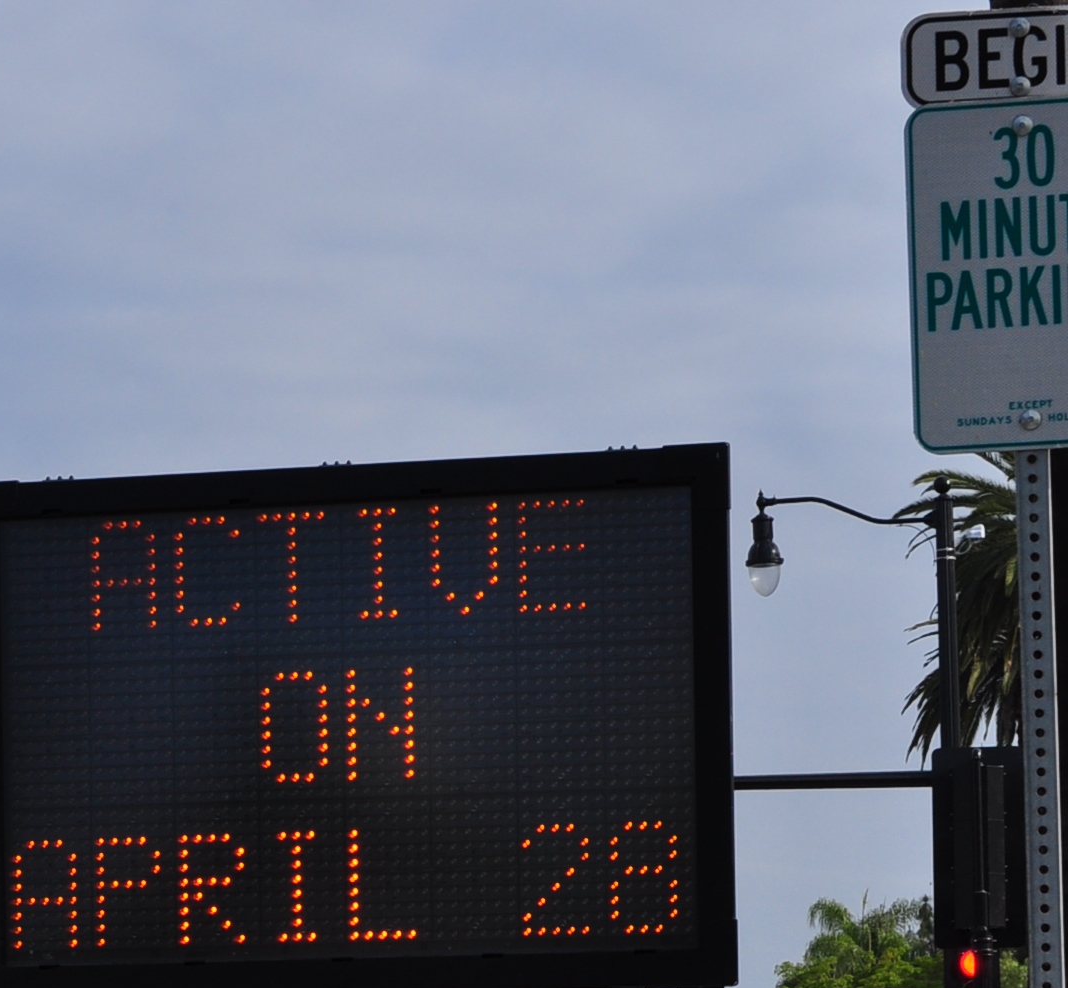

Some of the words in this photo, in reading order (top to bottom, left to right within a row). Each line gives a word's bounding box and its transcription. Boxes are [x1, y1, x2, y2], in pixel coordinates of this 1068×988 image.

[935, 24, 1067, 91] BEGI
[993, 124, 1055, 190] 30
[957, 415, 1013, 427] SUNDAYS
[1008, 399, 1053, 410] EXCEPT
[90, 499, 588, 632] ACTIVE
[260, 666, 415, 783] ON
[12, 829, 418, 950] APRIL
[521, 820, 679, 937] 28
